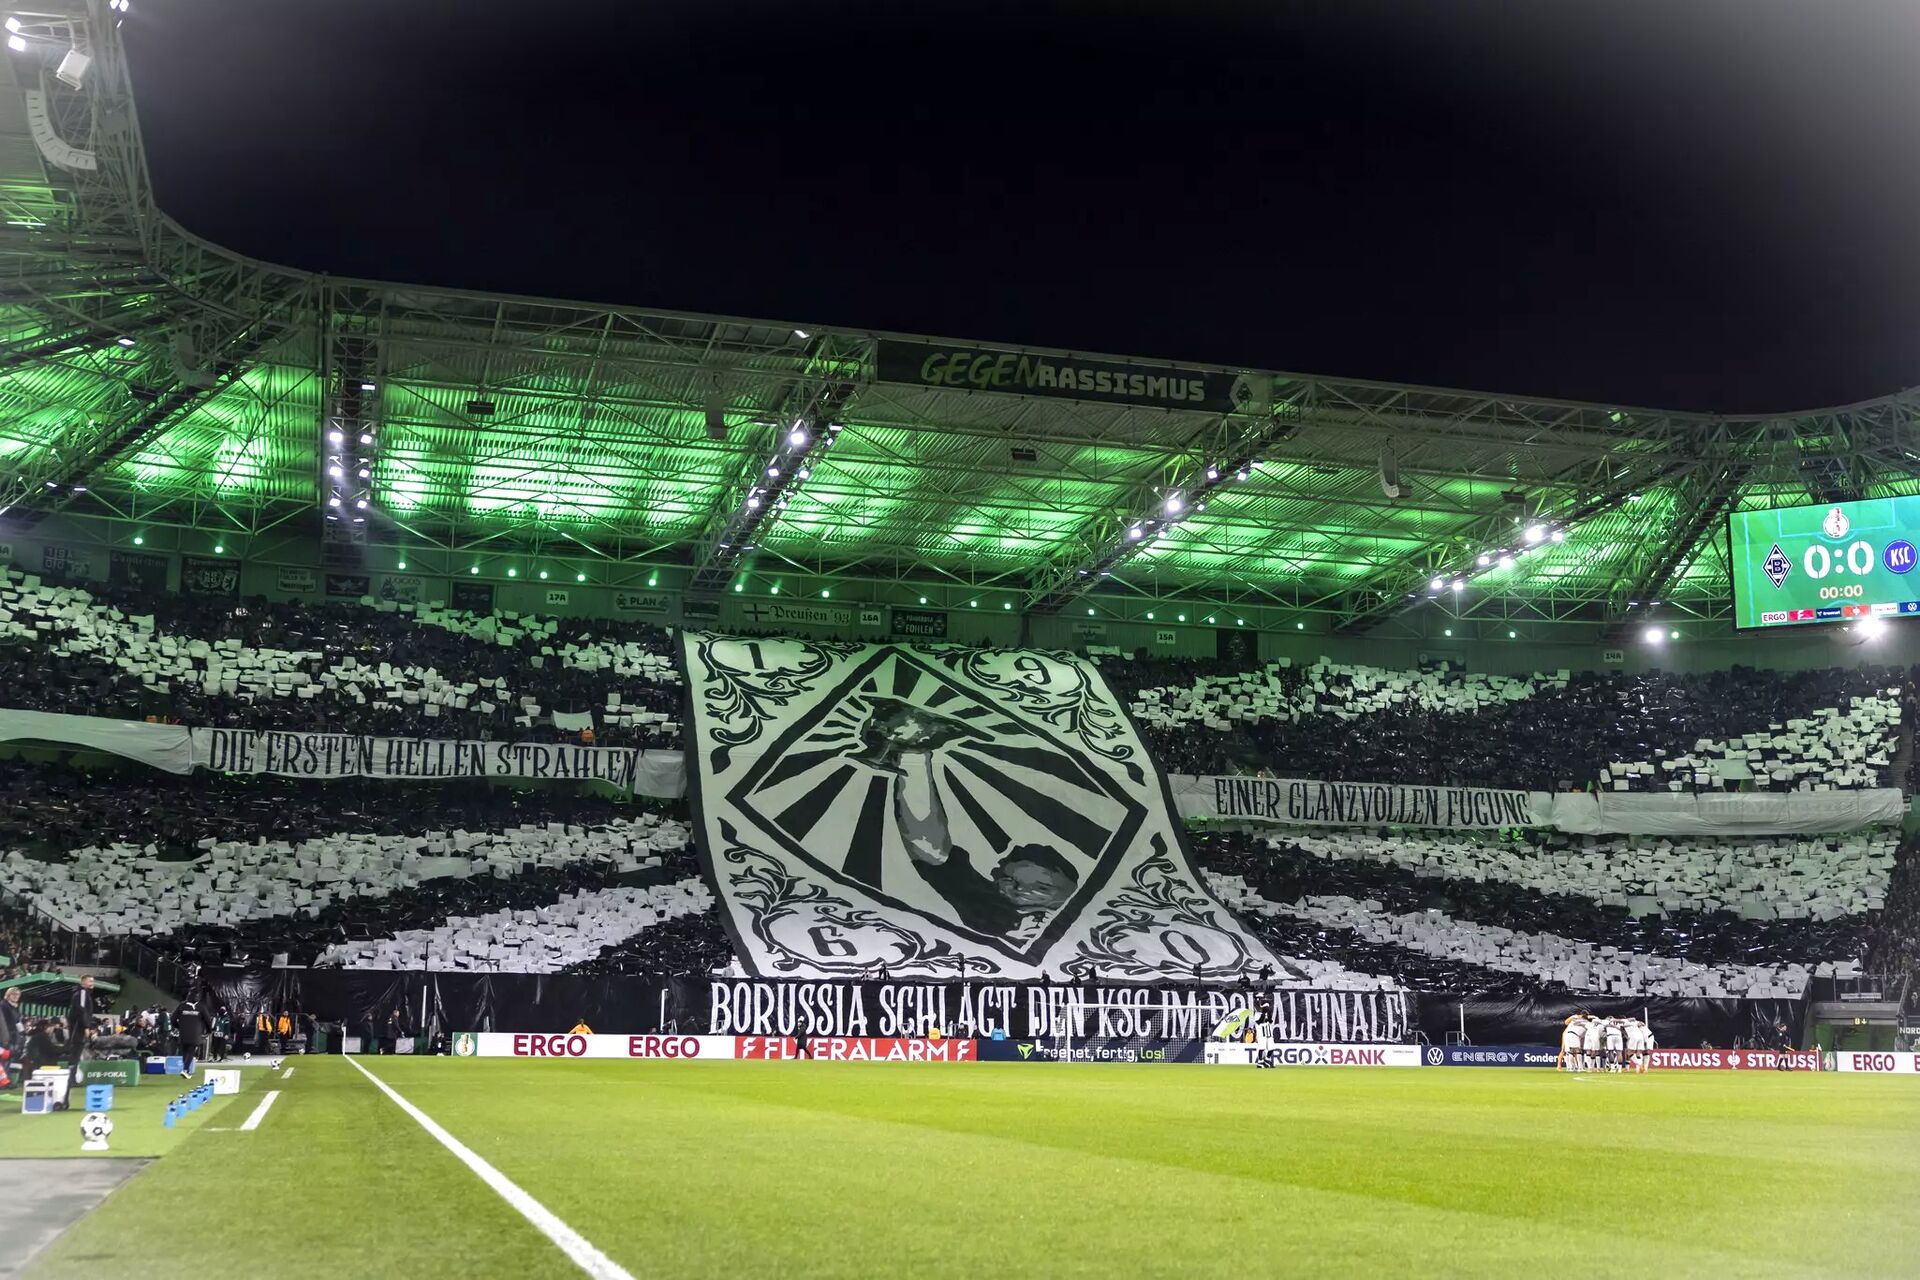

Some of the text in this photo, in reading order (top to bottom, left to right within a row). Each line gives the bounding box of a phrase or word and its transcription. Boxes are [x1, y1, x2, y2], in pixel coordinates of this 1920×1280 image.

[920, 353, 1205, 401] GEGEN RASSISMUS
[1804, 541, 1874, 579] 0:0
[1890, 546, 1911, 567] KSC
[548, 593, 566, 602] 17A
[1819, 585, 1863, 599] 00:00
[630, 597, 657, 607] PLAN
[770, 605, 828, 622] Preußen
[861, 614, 879, 623] 16A
[1763, 613, 1786, 622] ERGO
[1158, 633, 1174, 642] 15A
[1014, 656, 1052, 685] 9
[210, 728, 641, 789] DIE ERSTEN HELLEN STRAHLEN
[1215, 778, 1532, 826] EINER GLANZVOLLEN FÜGUNG
[811, 926, 858, 957] 6
[1158, 930, 1208, 965] 0
[710, 982, 868, 1037] BORUSSIA
[1027, 986, 1085, 1038] DEN
[1100, 987, 1151, 1038] KSC
[1161, 988, 1201, 1040] IM
[513, 1035, 700, 1058] ERGO ERGO
[1096, 1047, 1138, 1063] fertig,
[1140, 1047, 1165, 1060] los!
[1331, 1049, 1386, 1065] BANK
[1452, 1052, 1520, 1063] ENERGY
[1652, 1053, 1721, 1067] STRAUSS
[1853, 1054, 1895, 1071] ERGO
